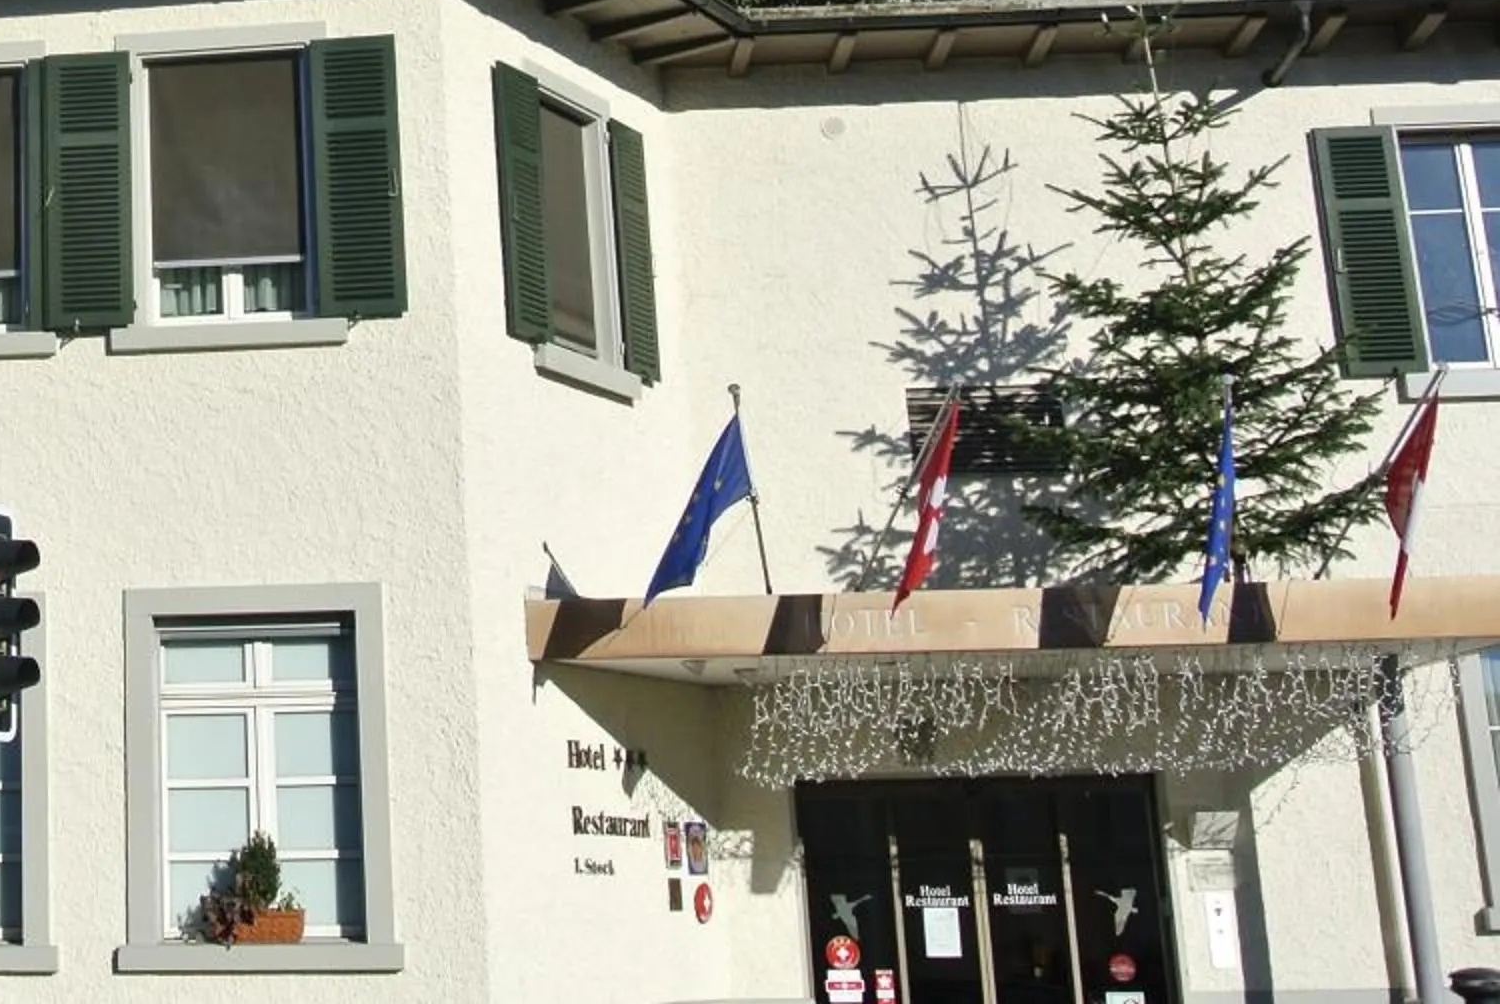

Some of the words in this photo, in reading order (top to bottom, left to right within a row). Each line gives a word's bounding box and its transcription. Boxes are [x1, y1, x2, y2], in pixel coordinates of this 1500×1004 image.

[567, 739, 607, 771] Hotel
[571, 805, 651, 839] Restaurant
[919, 884, 952, 897] Hotel
[1006, 882, 1040, 895] Hotel
[905, 894, 970, 908] Restaurant
[993, 892, 1058, 906] Restaurant
